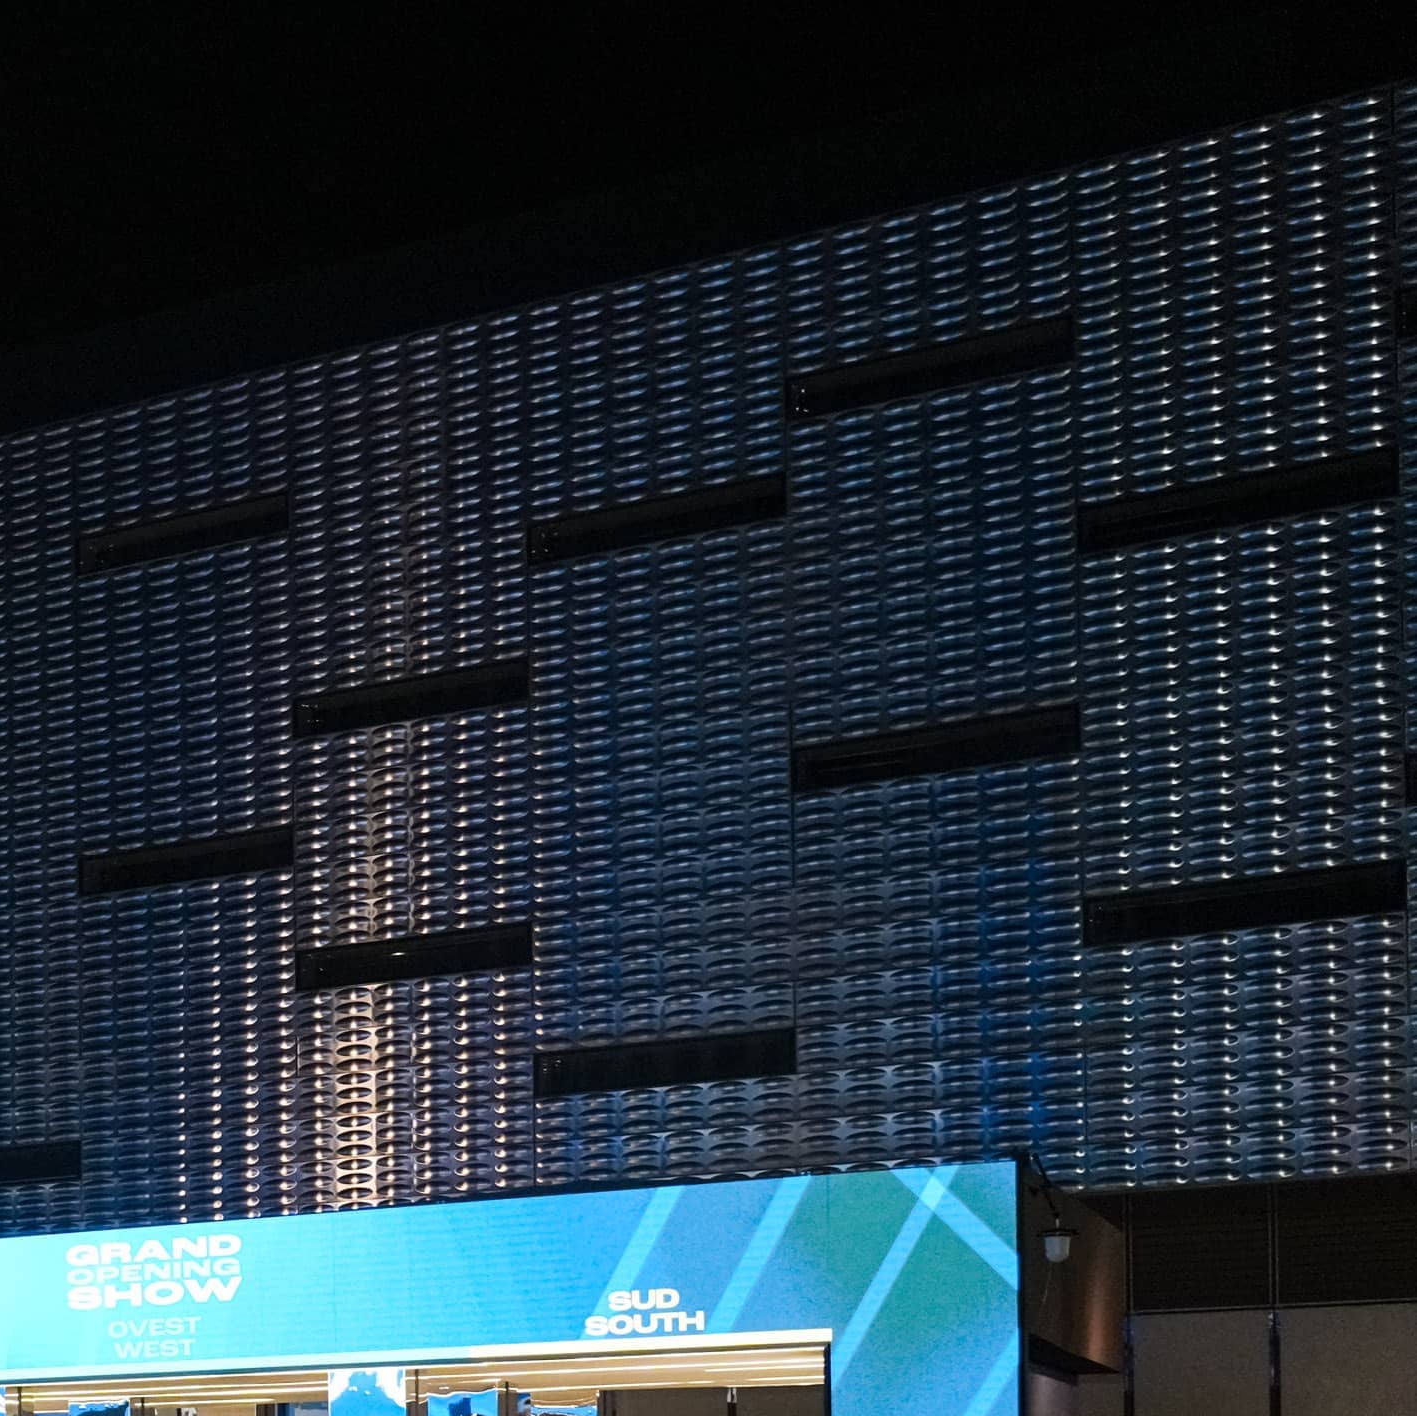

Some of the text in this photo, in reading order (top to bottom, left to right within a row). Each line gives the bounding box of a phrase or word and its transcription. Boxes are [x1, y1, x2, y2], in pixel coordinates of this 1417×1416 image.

[66, 1234, 242, 1266] GRAND
[66, 1257, 241, 1284] OPENING
[68, 1276, 243, 1310] SHOW
[608, 1288, 680, 1311] SUD
[108, 1316, 201, 1339] OVEST
[584, 1310, 705, 1336] SOUTH
[113, 1338, 196, 1359] WEST
